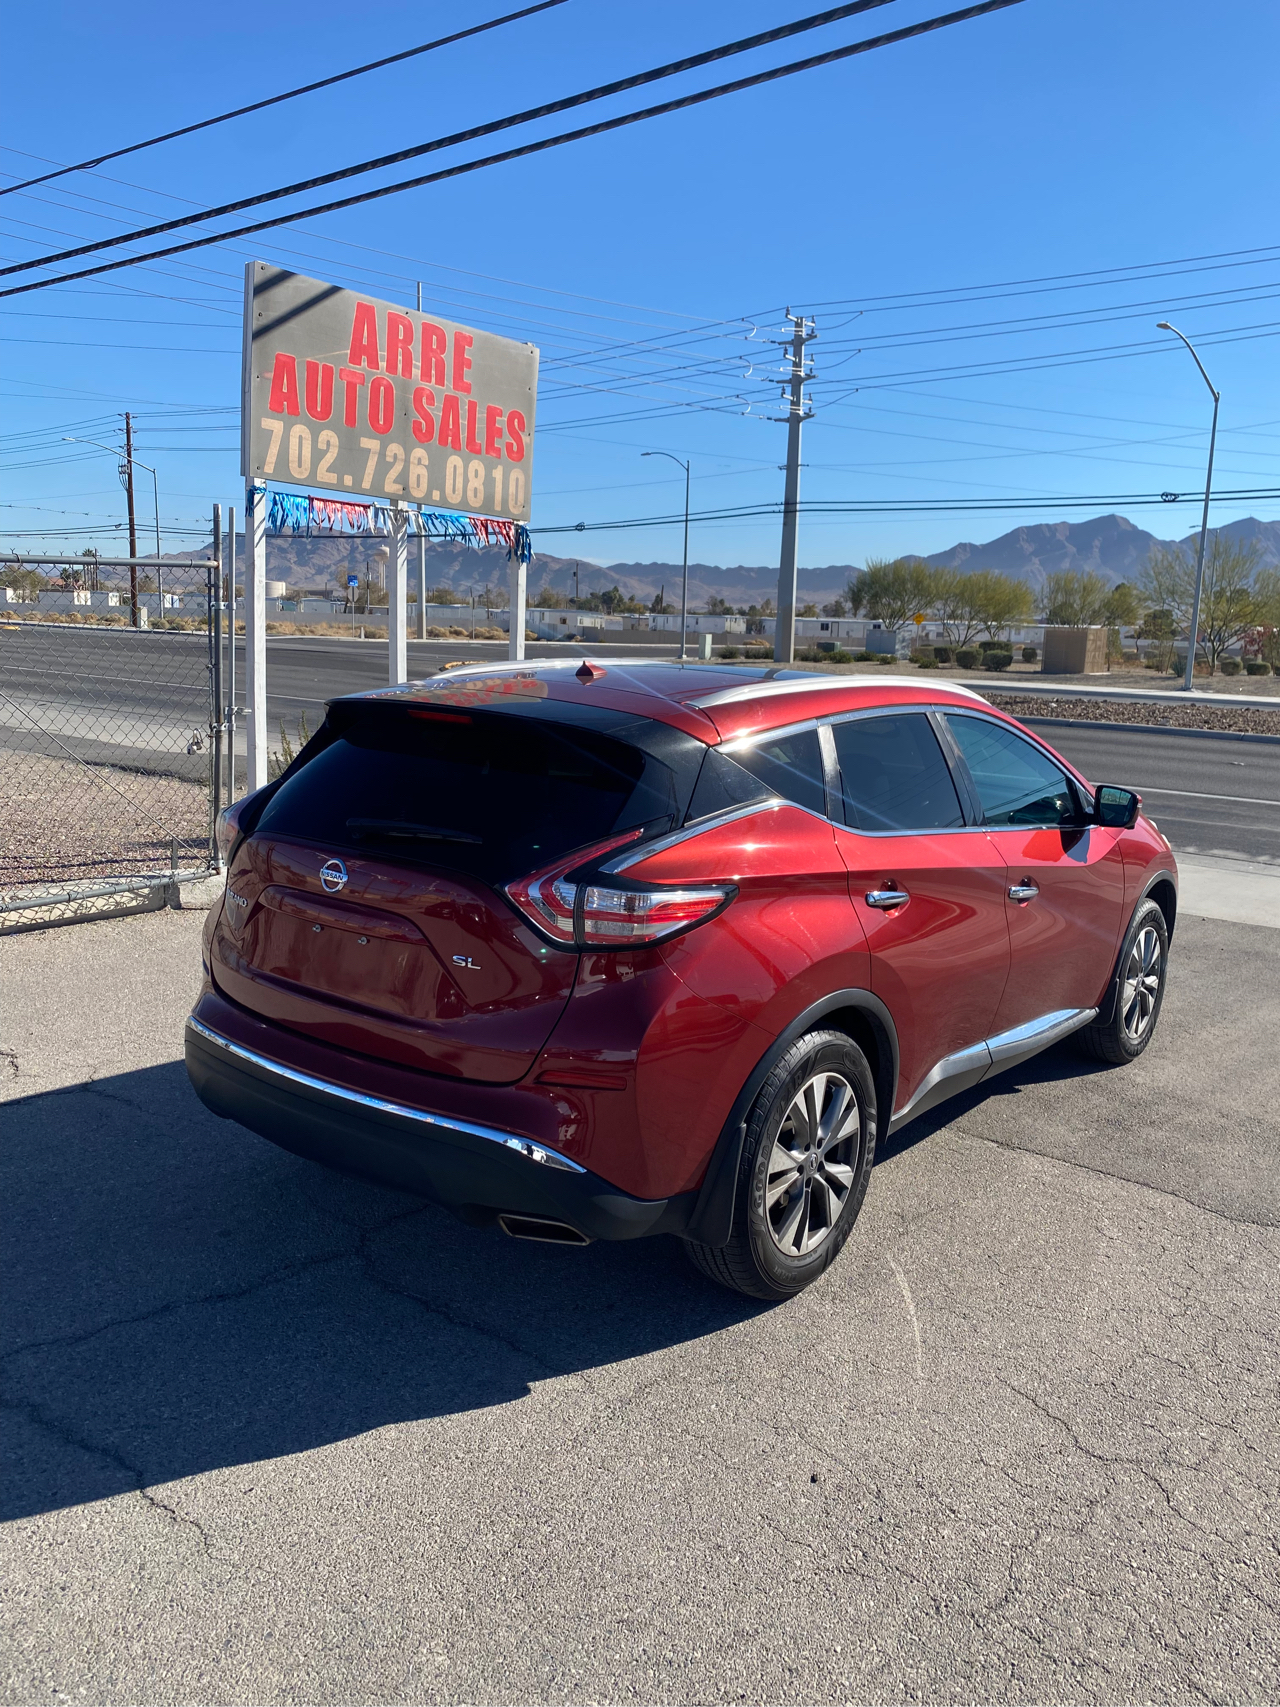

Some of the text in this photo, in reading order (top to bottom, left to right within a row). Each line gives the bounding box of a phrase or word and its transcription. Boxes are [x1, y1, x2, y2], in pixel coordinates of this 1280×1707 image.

[348, 301, 474, 394] ARRE
[268, 352, 527, 463] AUTO SALES
[260, 418, 525, 515] 702.726.0810
[320, 869, 345, 881] NISSAN
[452, 954, 481, 969] SL
